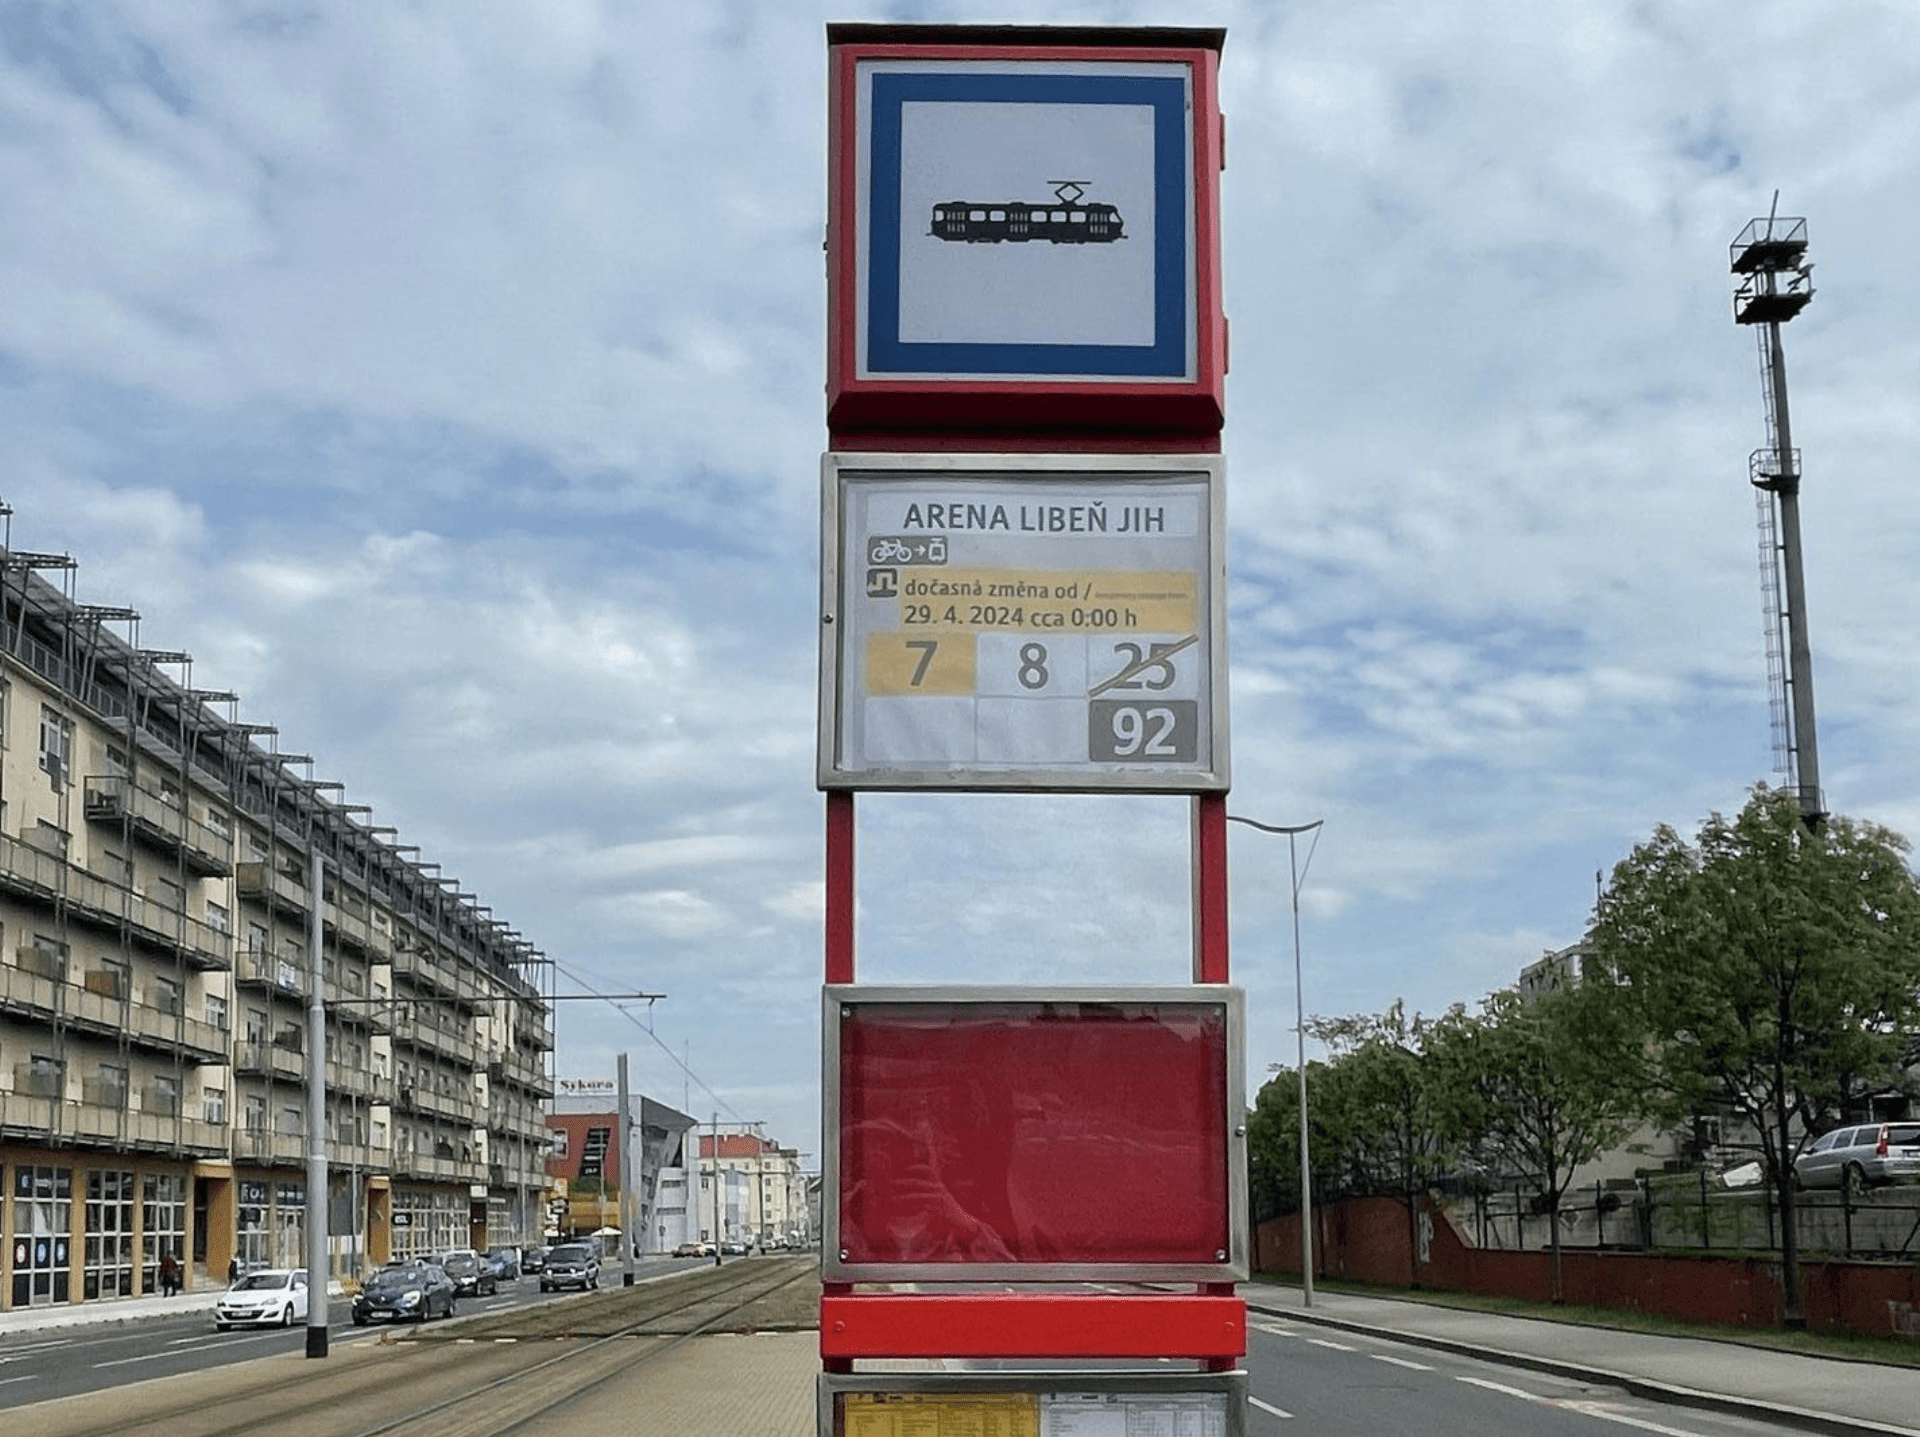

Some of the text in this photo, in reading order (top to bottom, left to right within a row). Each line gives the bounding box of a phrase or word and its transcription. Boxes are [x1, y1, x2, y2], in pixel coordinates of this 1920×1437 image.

[903, 501, 1164, 533] ARENA LIBEŇ JIH
[905, 579, 982, 597] dočasná
[988, 580, 1049, 599] změna
[1055, 582, 1078, 599] od
[904, 605, 1137, 628] 29. 4. 2024 cca 0:00 h
[905, 640, 1176, 690] 7 8 25
[1111, 706, 1177, 756] 92
